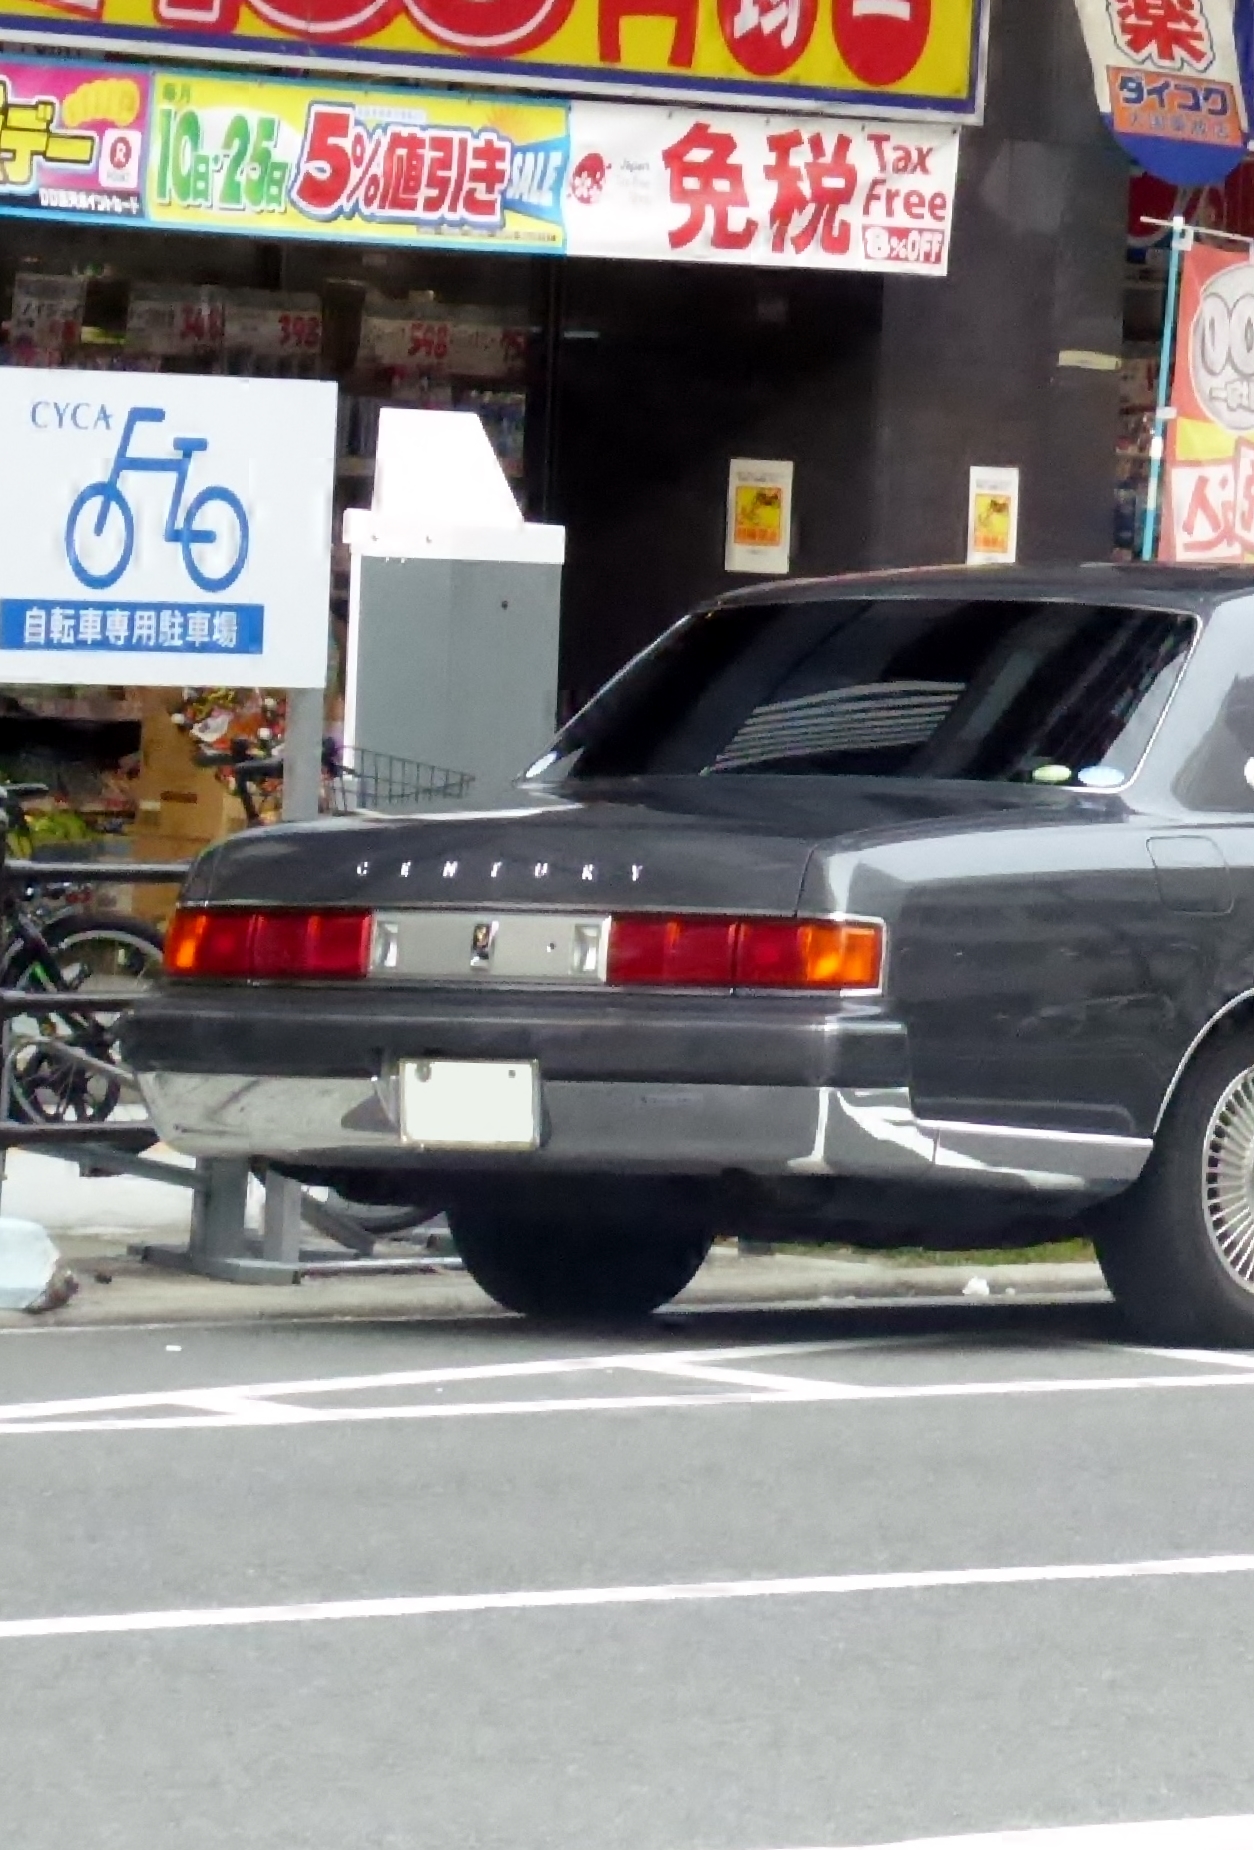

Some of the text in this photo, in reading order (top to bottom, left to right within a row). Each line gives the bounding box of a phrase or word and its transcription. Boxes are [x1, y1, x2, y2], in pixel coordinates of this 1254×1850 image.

[1119, 75, 1229, 116] ダイコク
[296, 111, 506, 216] 5%値引き
[866, 133, 934, 175] Tax
[507, 151, 562, 206] SALE
[661, 121, 858, 256] 免税
[862, 177, 947, 222] Free
[865, 227, 943, 264] 8%OFF
[30, 400, 113, 431] CYCA
[24, 607, 239, 649] 自転車専用駐車場
